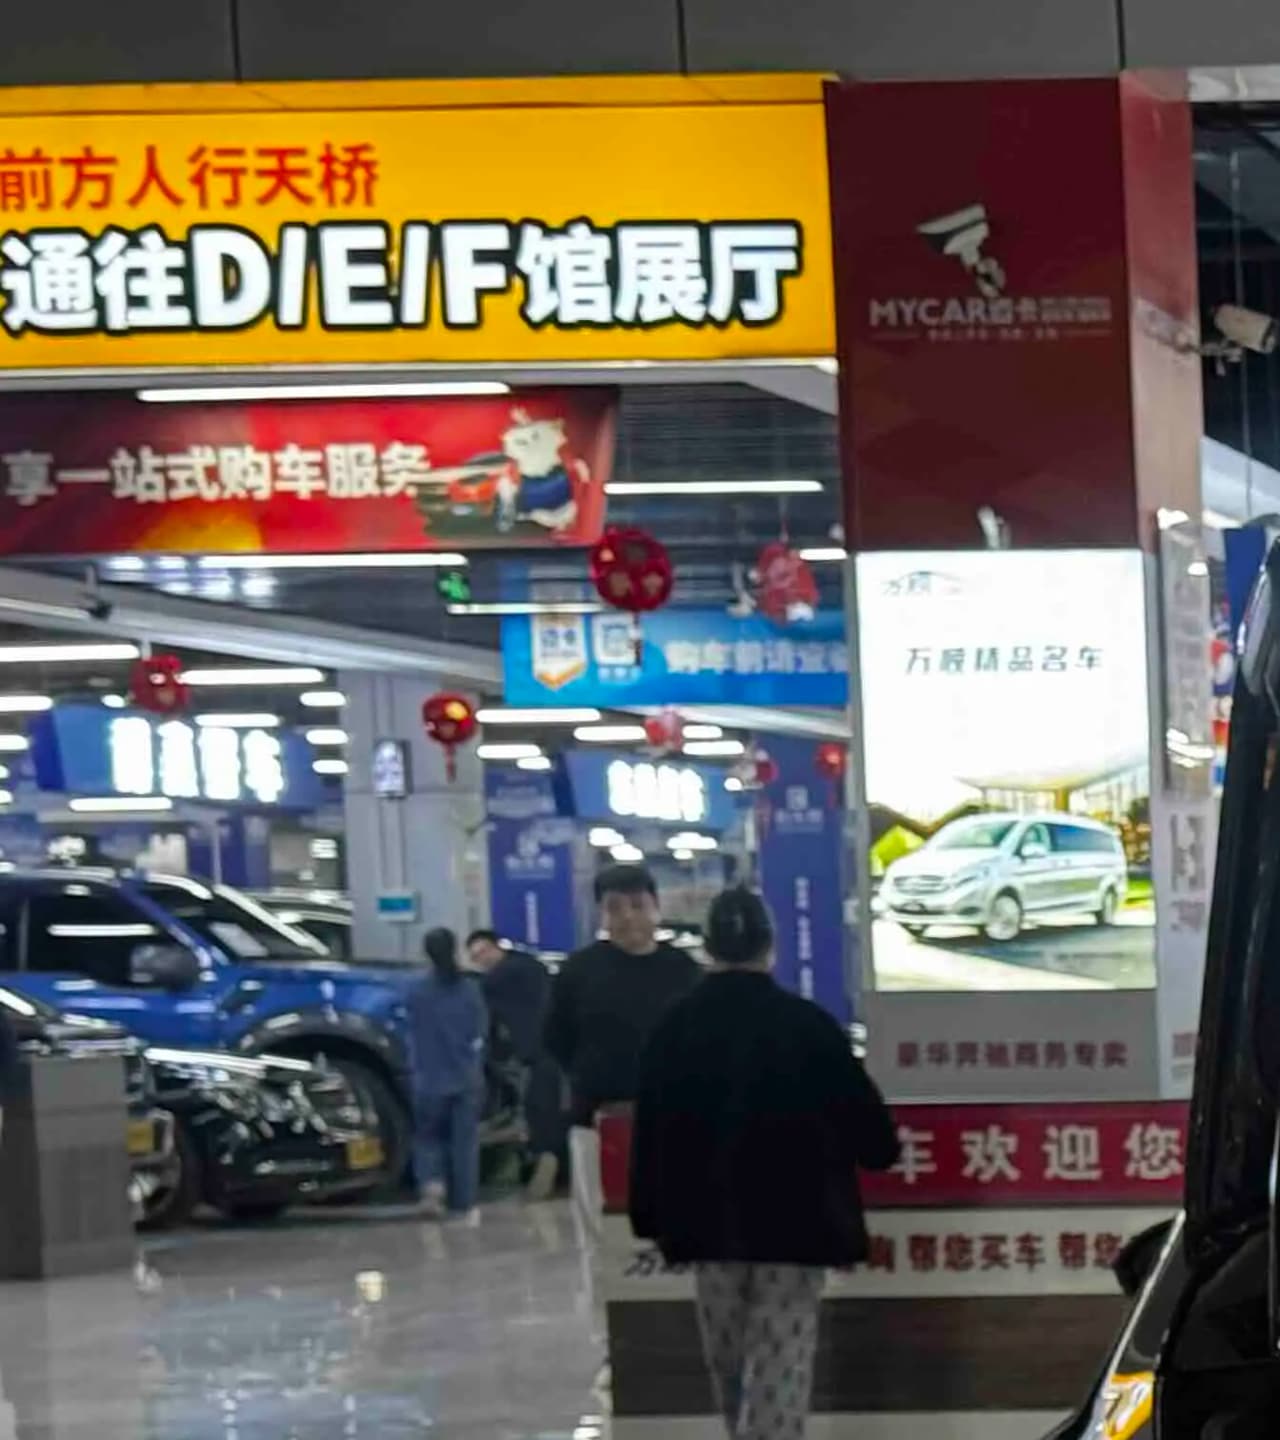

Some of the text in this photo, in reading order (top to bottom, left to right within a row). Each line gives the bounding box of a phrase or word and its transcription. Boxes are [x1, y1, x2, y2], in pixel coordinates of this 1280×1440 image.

[0, 142, 380, 212] 前方人行天桥
[4, 444, 430, 506] 享一站式购车服务
